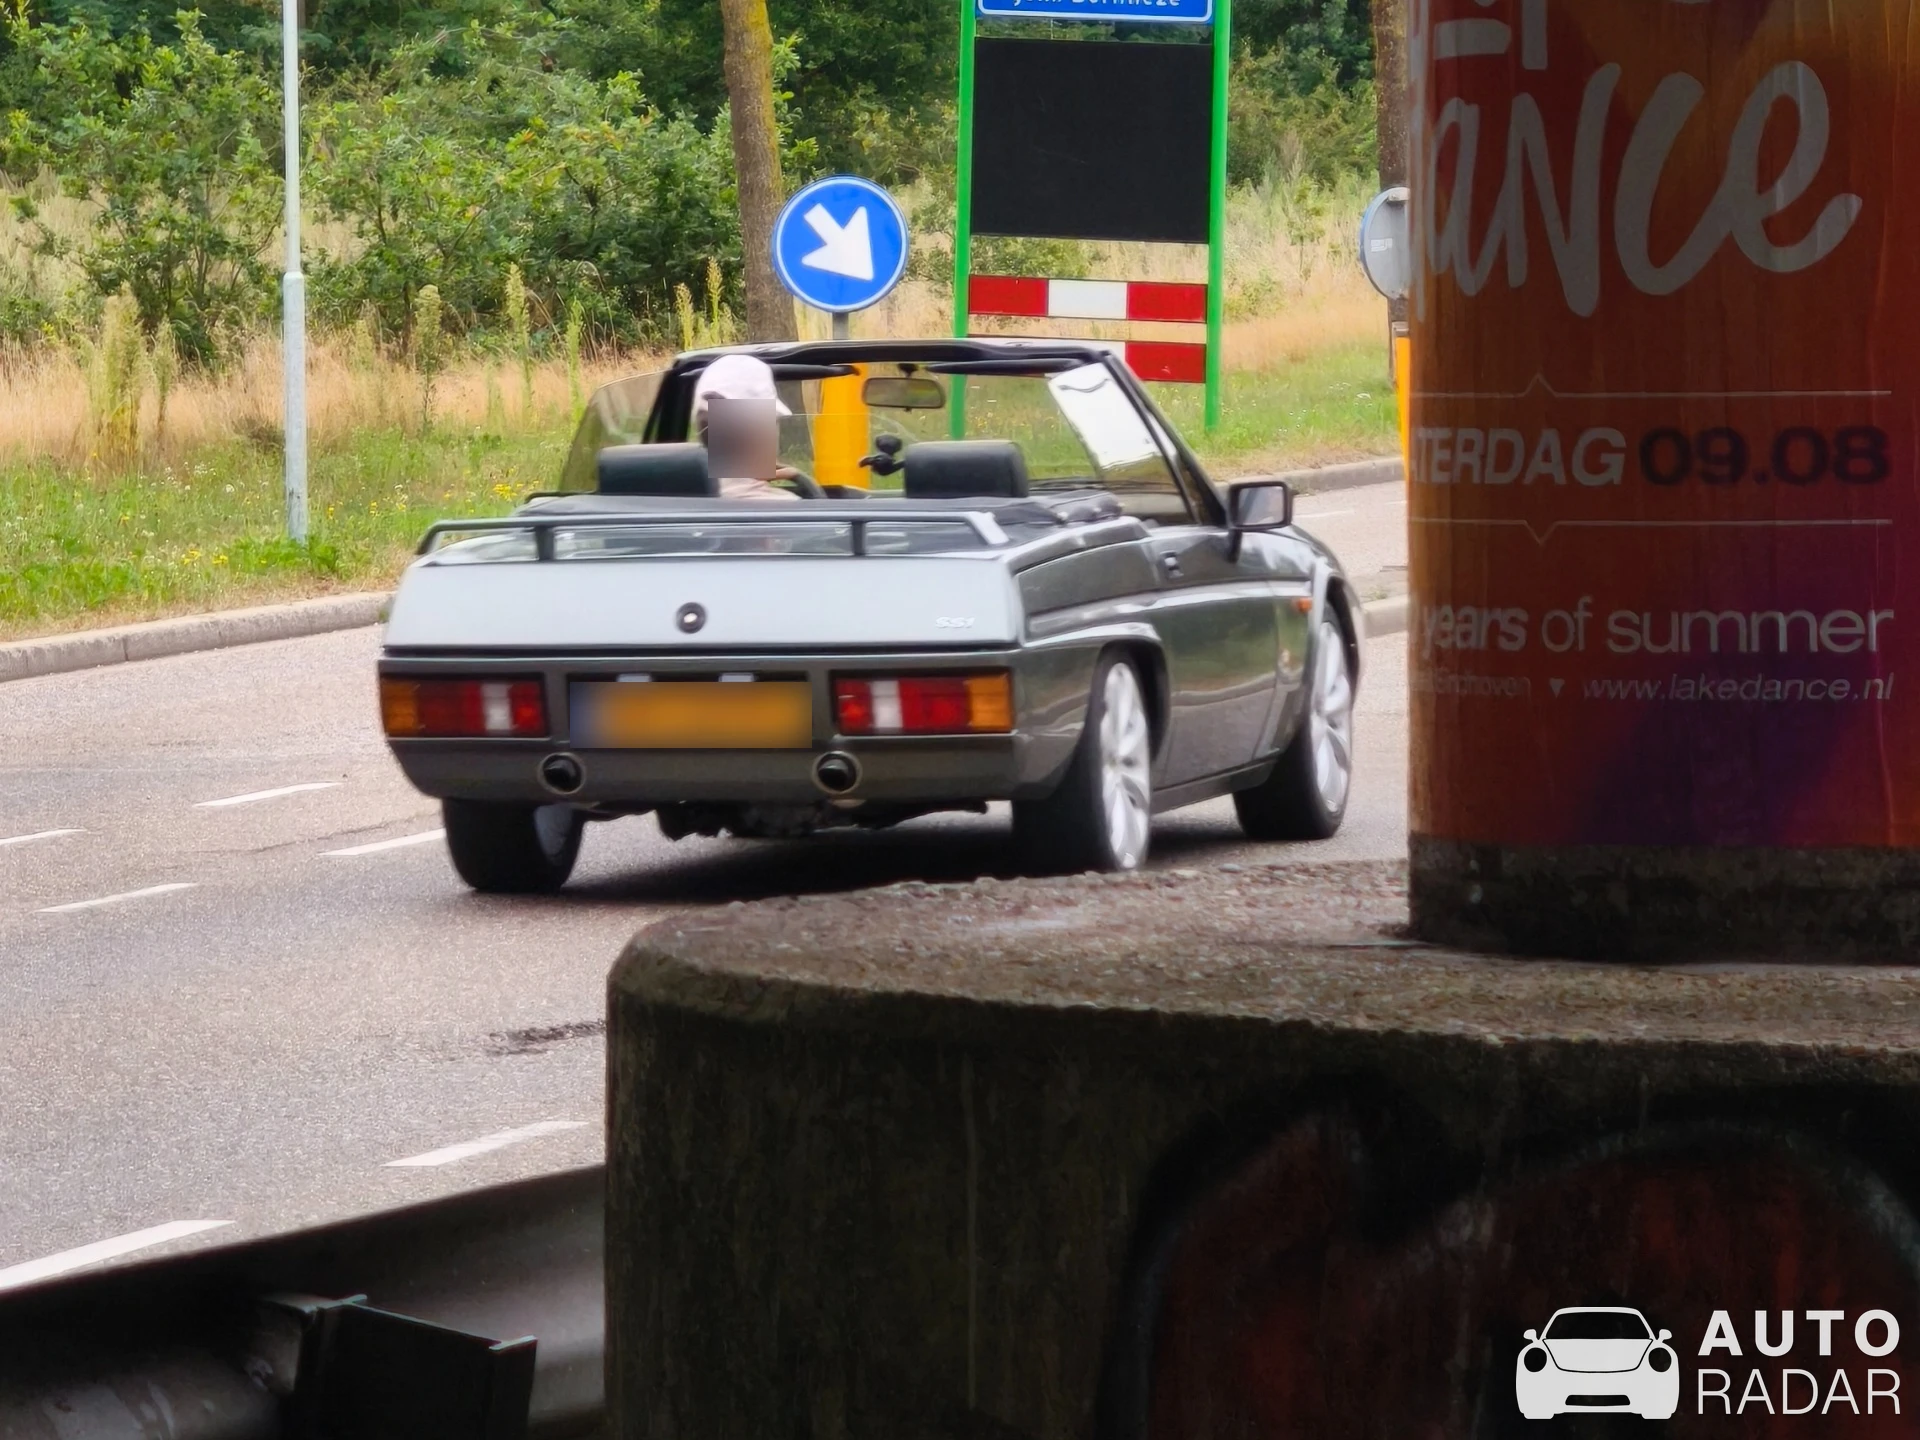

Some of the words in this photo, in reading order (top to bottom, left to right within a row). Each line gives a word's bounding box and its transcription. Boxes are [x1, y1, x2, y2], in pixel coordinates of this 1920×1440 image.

[1639, 425, 1890, 487] 09.08
[1422, 604, 1529, 660] years
[1541, 596, 1593, 652] of
[1607, 608, 1894, 653] summer
[1583, 672, 1894, 701] www.lakedance.nl
